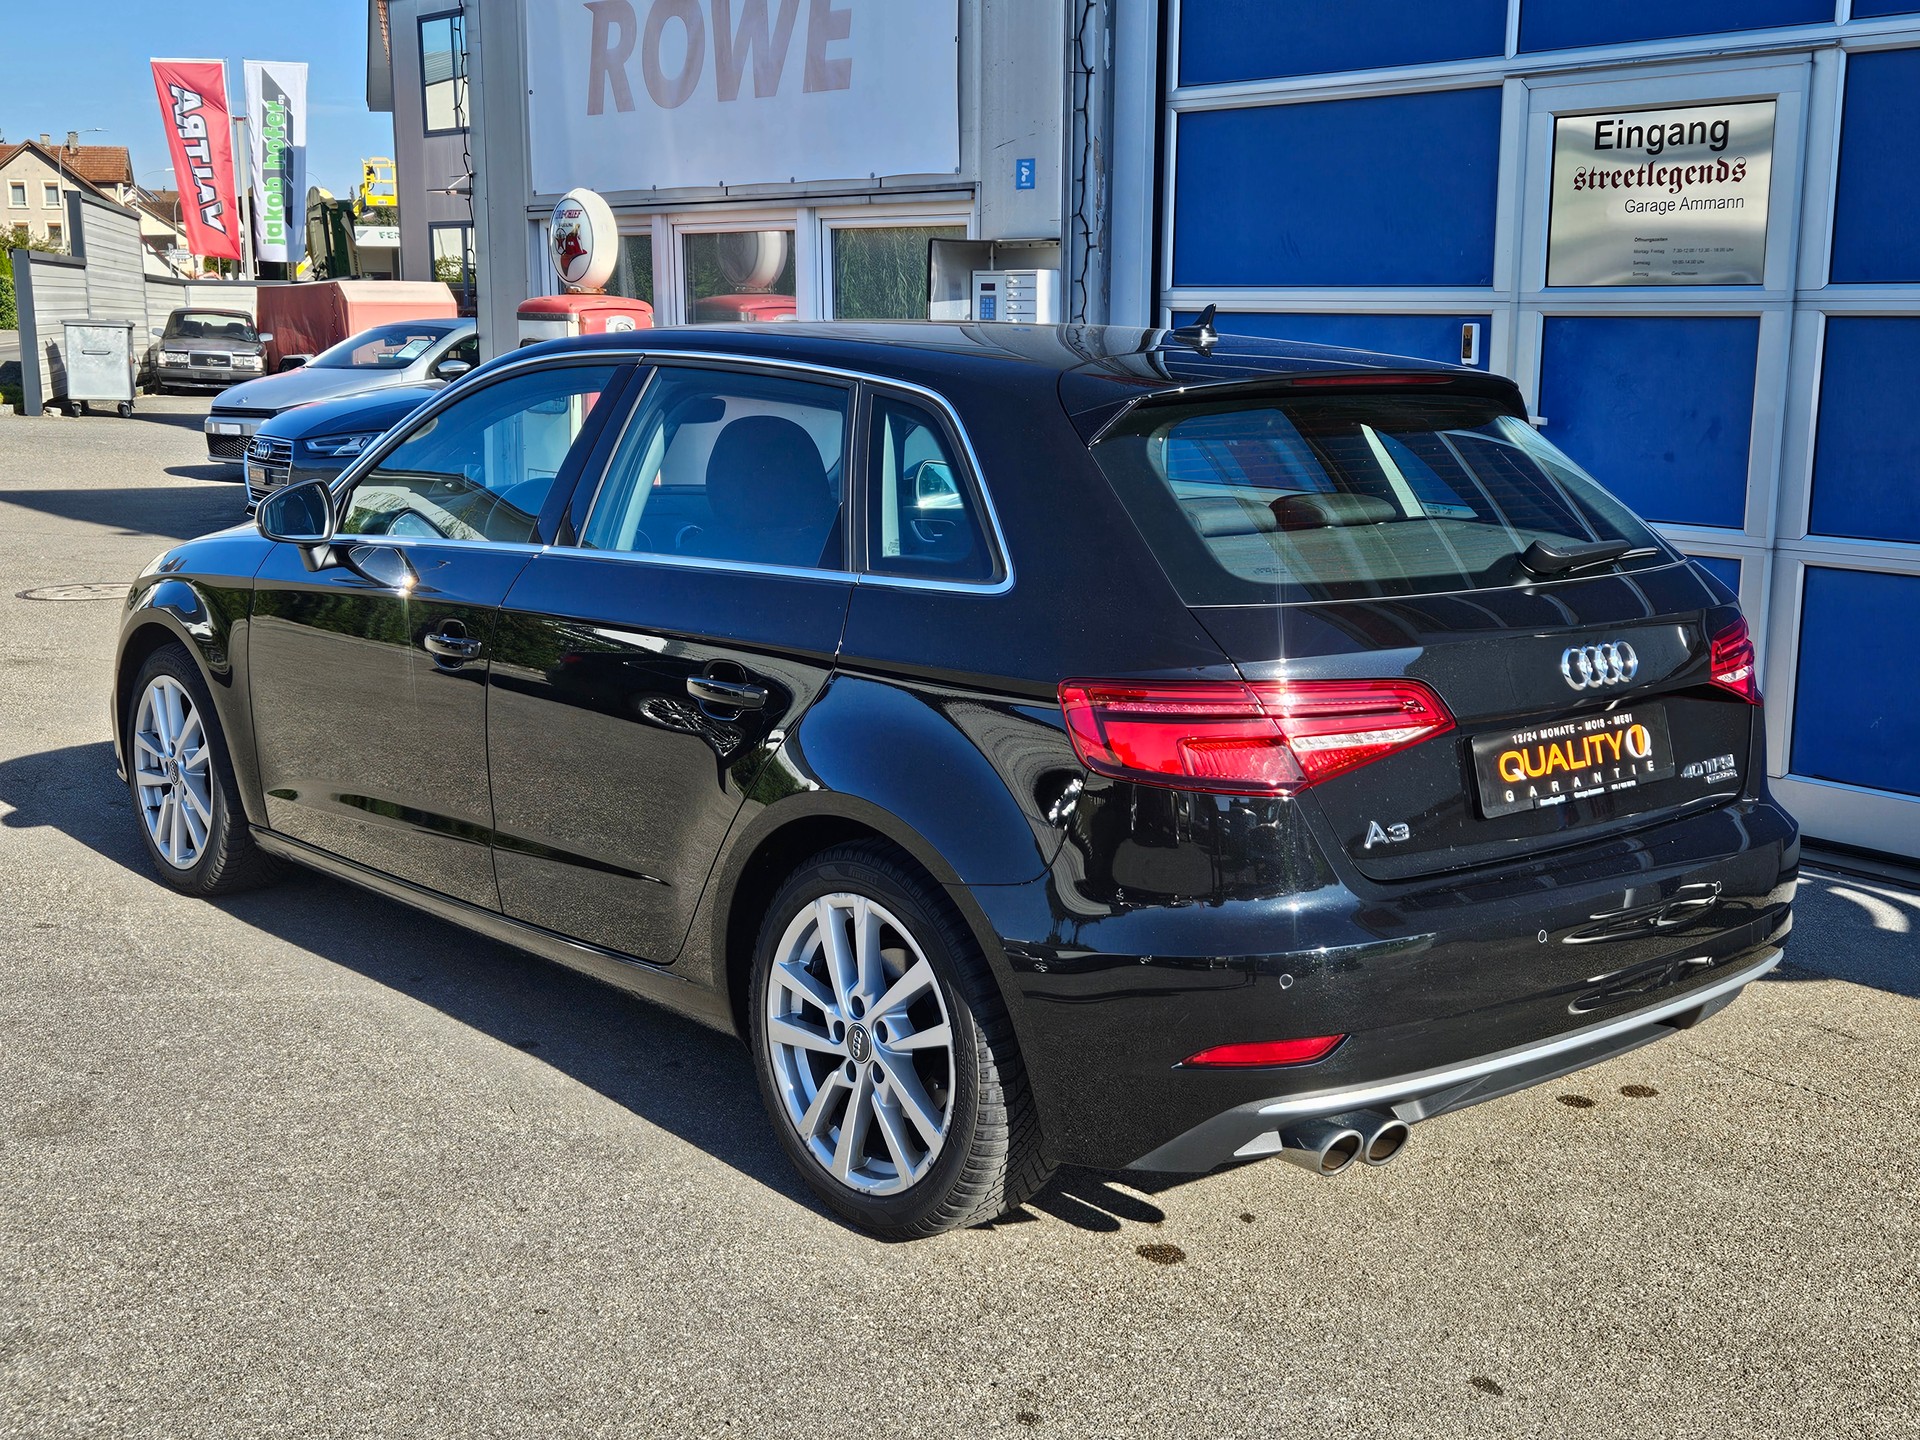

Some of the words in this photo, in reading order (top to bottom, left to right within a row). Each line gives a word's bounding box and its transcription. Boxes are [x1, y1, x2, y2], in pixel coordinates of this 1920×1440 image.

[583, 0, 852, 116] ROWE
[263, 100, 285, 170] hofer
[1594, 119, 1730, 155] Eingang
[1573, 156, 1747, 194] streetlegends
[263, 176, 286, 246] jakob
[1624, 199, 1676, 215] Garage
[1679, 197, 1745, 211] Ammann
[1512, 731, 1538, 745] 12/24
[1540, 724, 1576, 739] MONATE
[1584, 717, 1606, 730] MOIS
[1613, 713, 1634, 725] MESI
[1499, 730, 1624, 783] QUALITY
[1505, 760, 1655, 803] GARANTIE
[1363, 820, 1410, 849] A3
